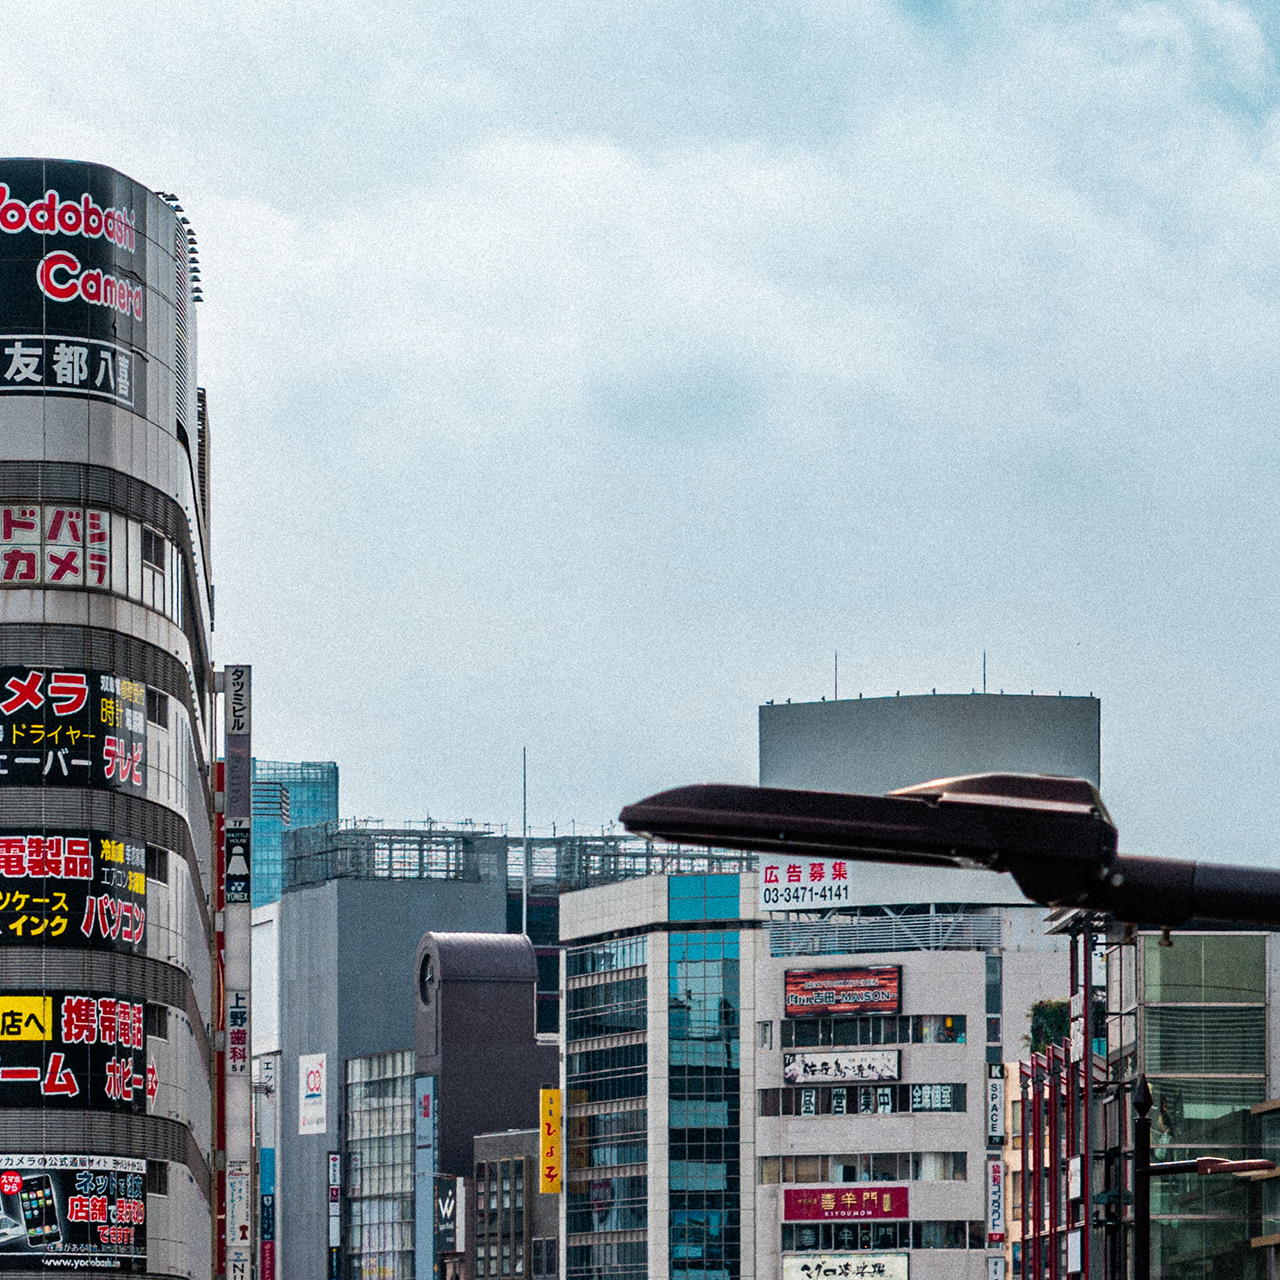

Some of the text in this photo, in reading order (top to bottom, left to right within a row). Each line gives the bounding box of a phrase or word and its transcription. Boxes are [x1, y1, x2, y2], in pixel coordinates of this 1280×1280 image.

[36, 249, 142, 322] Camera
[4, 341, 130, 397] 友都八喜
[2, 548, 108, 586] カメラ
[232, 668, 246, 731] タツミビル
[11, 723, 96, 745] ドライヤー
[103, 735, 143, 786] テレビ
[226, 892, 248, 901] YONEX
[763, 861, 849, 884] 広告募集
[763, 885, 849, 904] 03-3471-4141
[8, 915, 68, 937] インク
[81, 893, 145, 945] パソコン
[61, 996, 144, 1050] 携帯電話
[229, 993, 248, 1062] 上野歯科
[990, 1083, 1000, 1132] SPACE
[1, 1175, 20, 1183] スマホ
[3, 1183, 18, 1191] から
